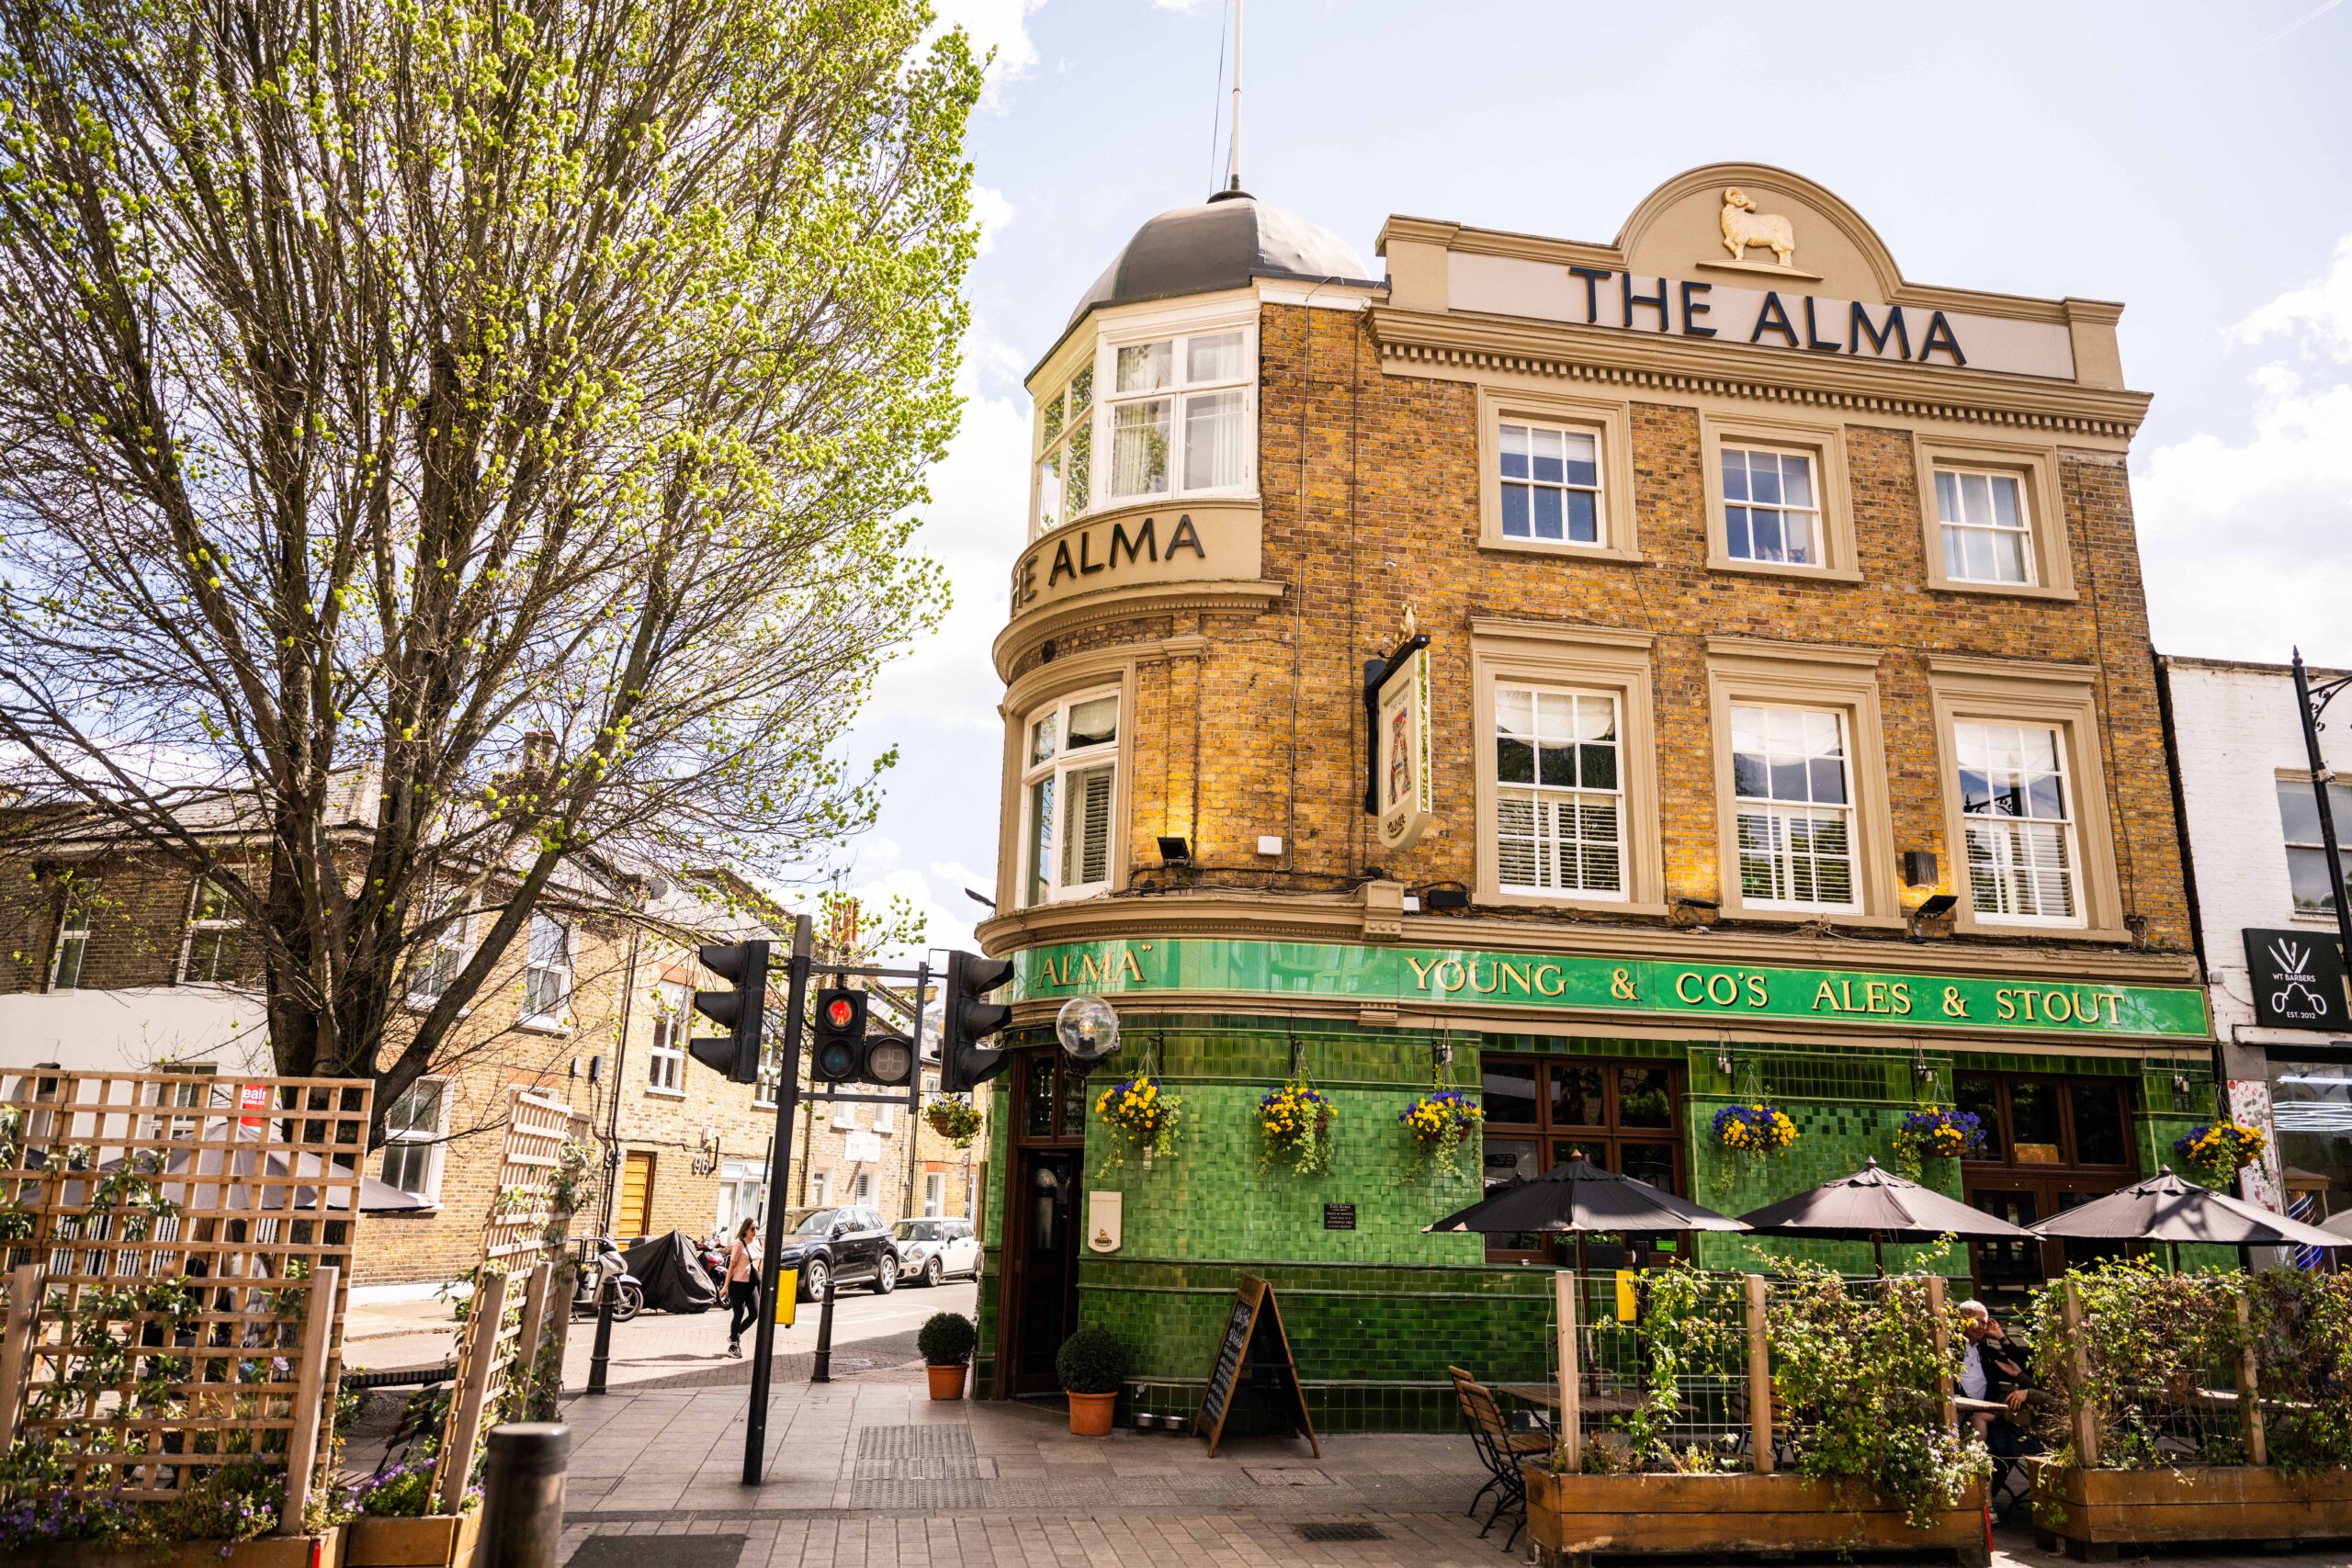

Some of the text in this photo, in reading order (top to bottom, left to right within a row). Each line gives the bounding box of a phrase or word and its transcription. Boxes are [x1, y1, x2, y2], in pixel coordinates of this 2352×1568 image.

[1568, 266, 1968, 366] THE ALMA
[1010, 513, 1205, 617] HE ALMA
[1404, 956, 1566, 997] YOUNG
[1610, 967, 1641, 1001] &
[1811, 979, 1912, 1015] ALES
[1942, 986, 1972, 1019] &
[1996, 988, 2127, 1025] STOUT
[2285, 974, 2315, 982] BARBERS
[694, 1156, 709, 1173] 96
